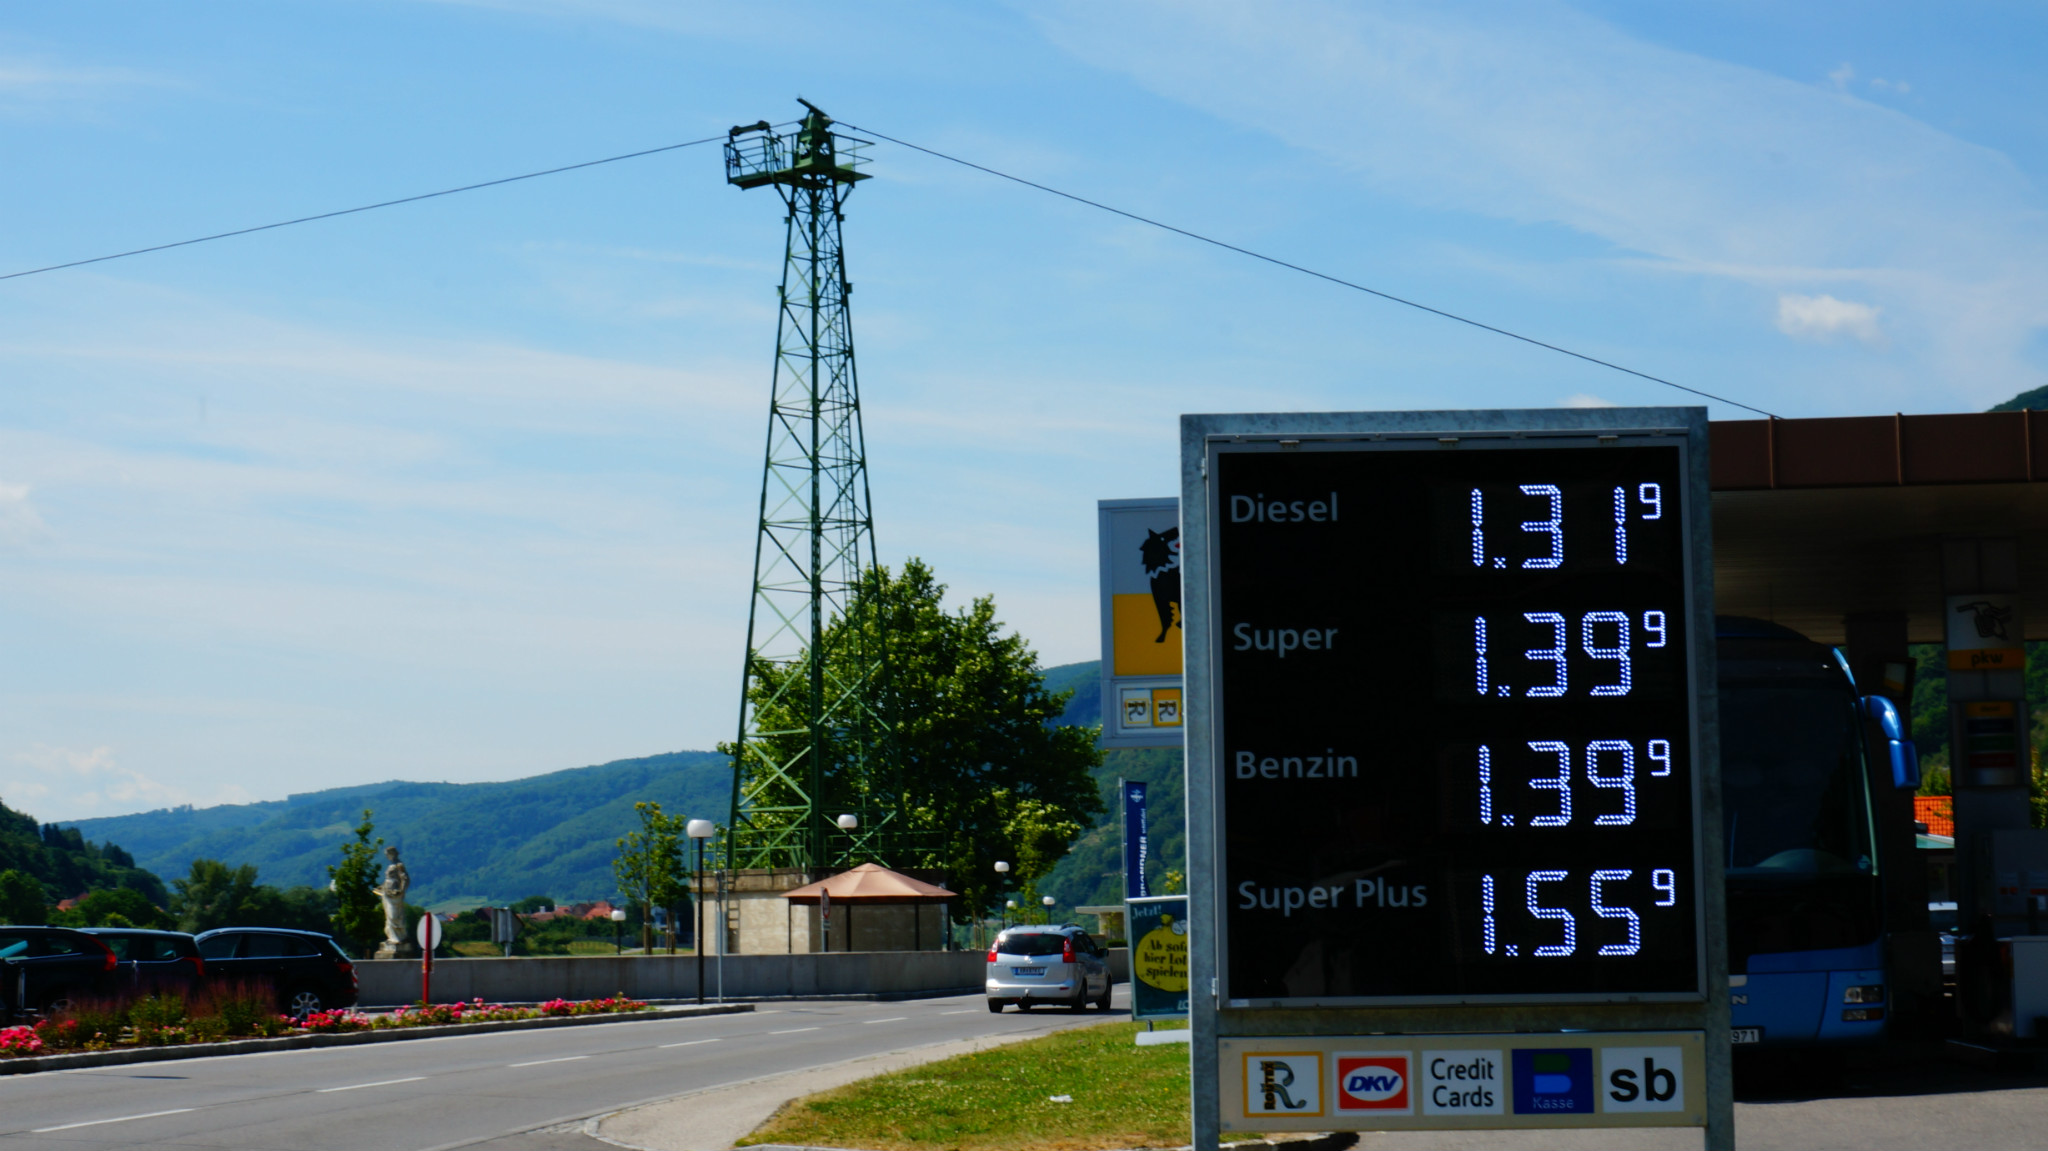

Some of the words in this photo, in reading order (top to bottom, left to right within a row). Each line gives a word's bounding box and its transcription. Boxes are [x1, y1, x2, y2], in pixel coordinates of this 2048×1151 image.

[1231, 491, 1338, 523] Diesel
[1233, 622, 1338, 658] Super
[1971, 650, 2004, 668] pkw
[1236, 747, 1358, 779] Benzin
[1238, 880, 1345, 917] Super
[1355, 876, 1427, 908] Plus
[1132, 904, 1162, 920] Jetzt!
[1150, 939, 1162, 950] Ab
[1144, 952, 1166, 964] hier
[1430, 1058, 1494, 1081] Credit
[1610, 1057, 1677, 1103] sb
[1347, 1075, 1400, 1092] DKV
[1432, 1085, 1494, 1108] Cards
[1532, 1096, 1574, 1109] Kasse
